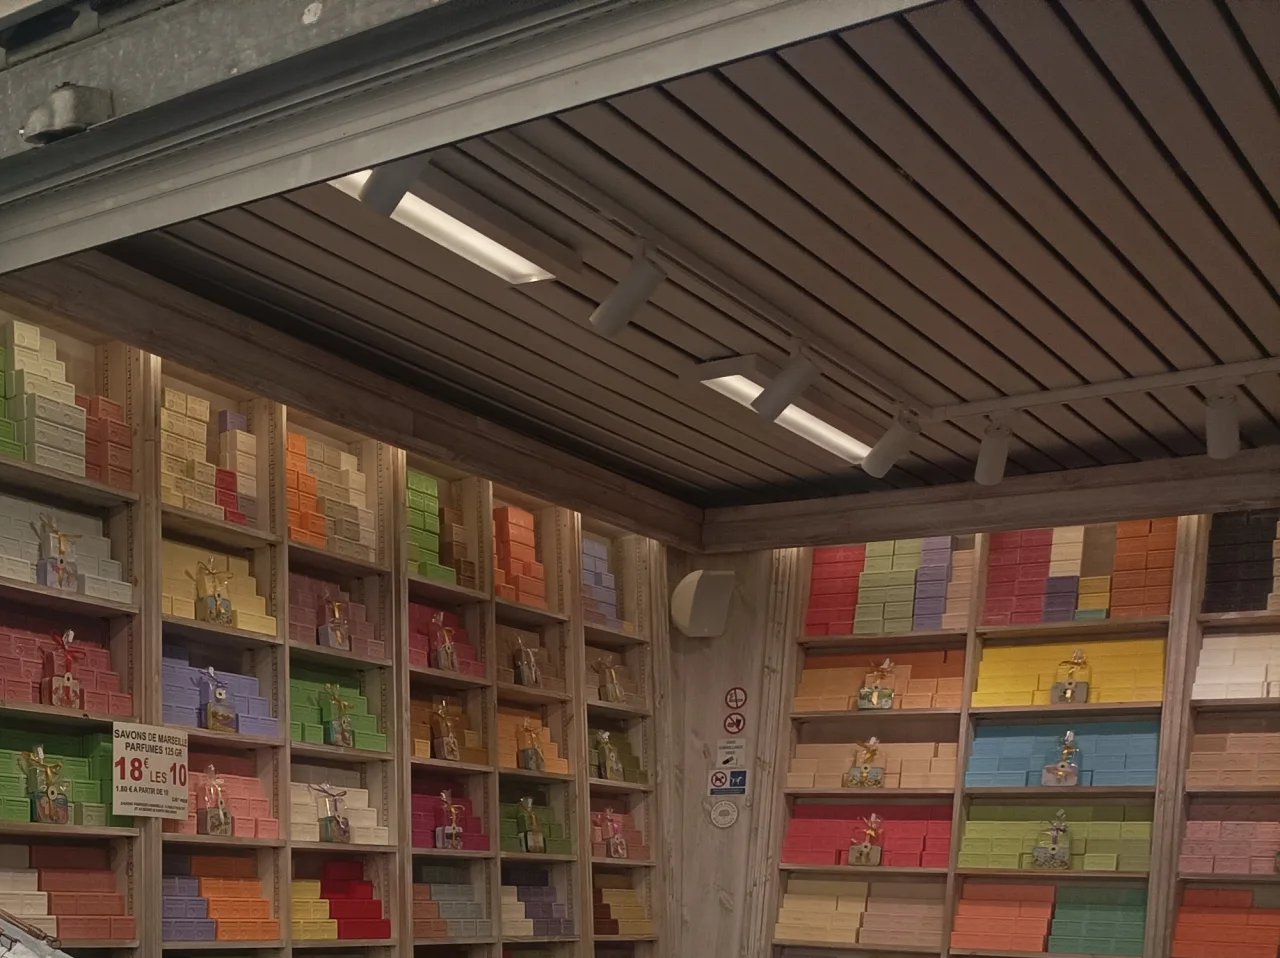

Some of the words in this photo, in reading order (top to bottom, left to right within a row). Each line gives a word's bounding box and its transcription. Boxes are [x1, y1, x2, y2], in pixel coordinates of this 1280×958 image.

[114, 729, 147, 741] SAVONS
[148, 733, 157, 742] DE
[158, 734, 187, 747] MARSEILLE
[125, 742, 163, 755] PARFUMES
[165, 747, 174, 756] 125
[175, 748, 182, 757] GR
[150, 771, 167, 784] LES
[170, 762, 187, 787] 10
[139, 786, 156, 795] PARTIR
